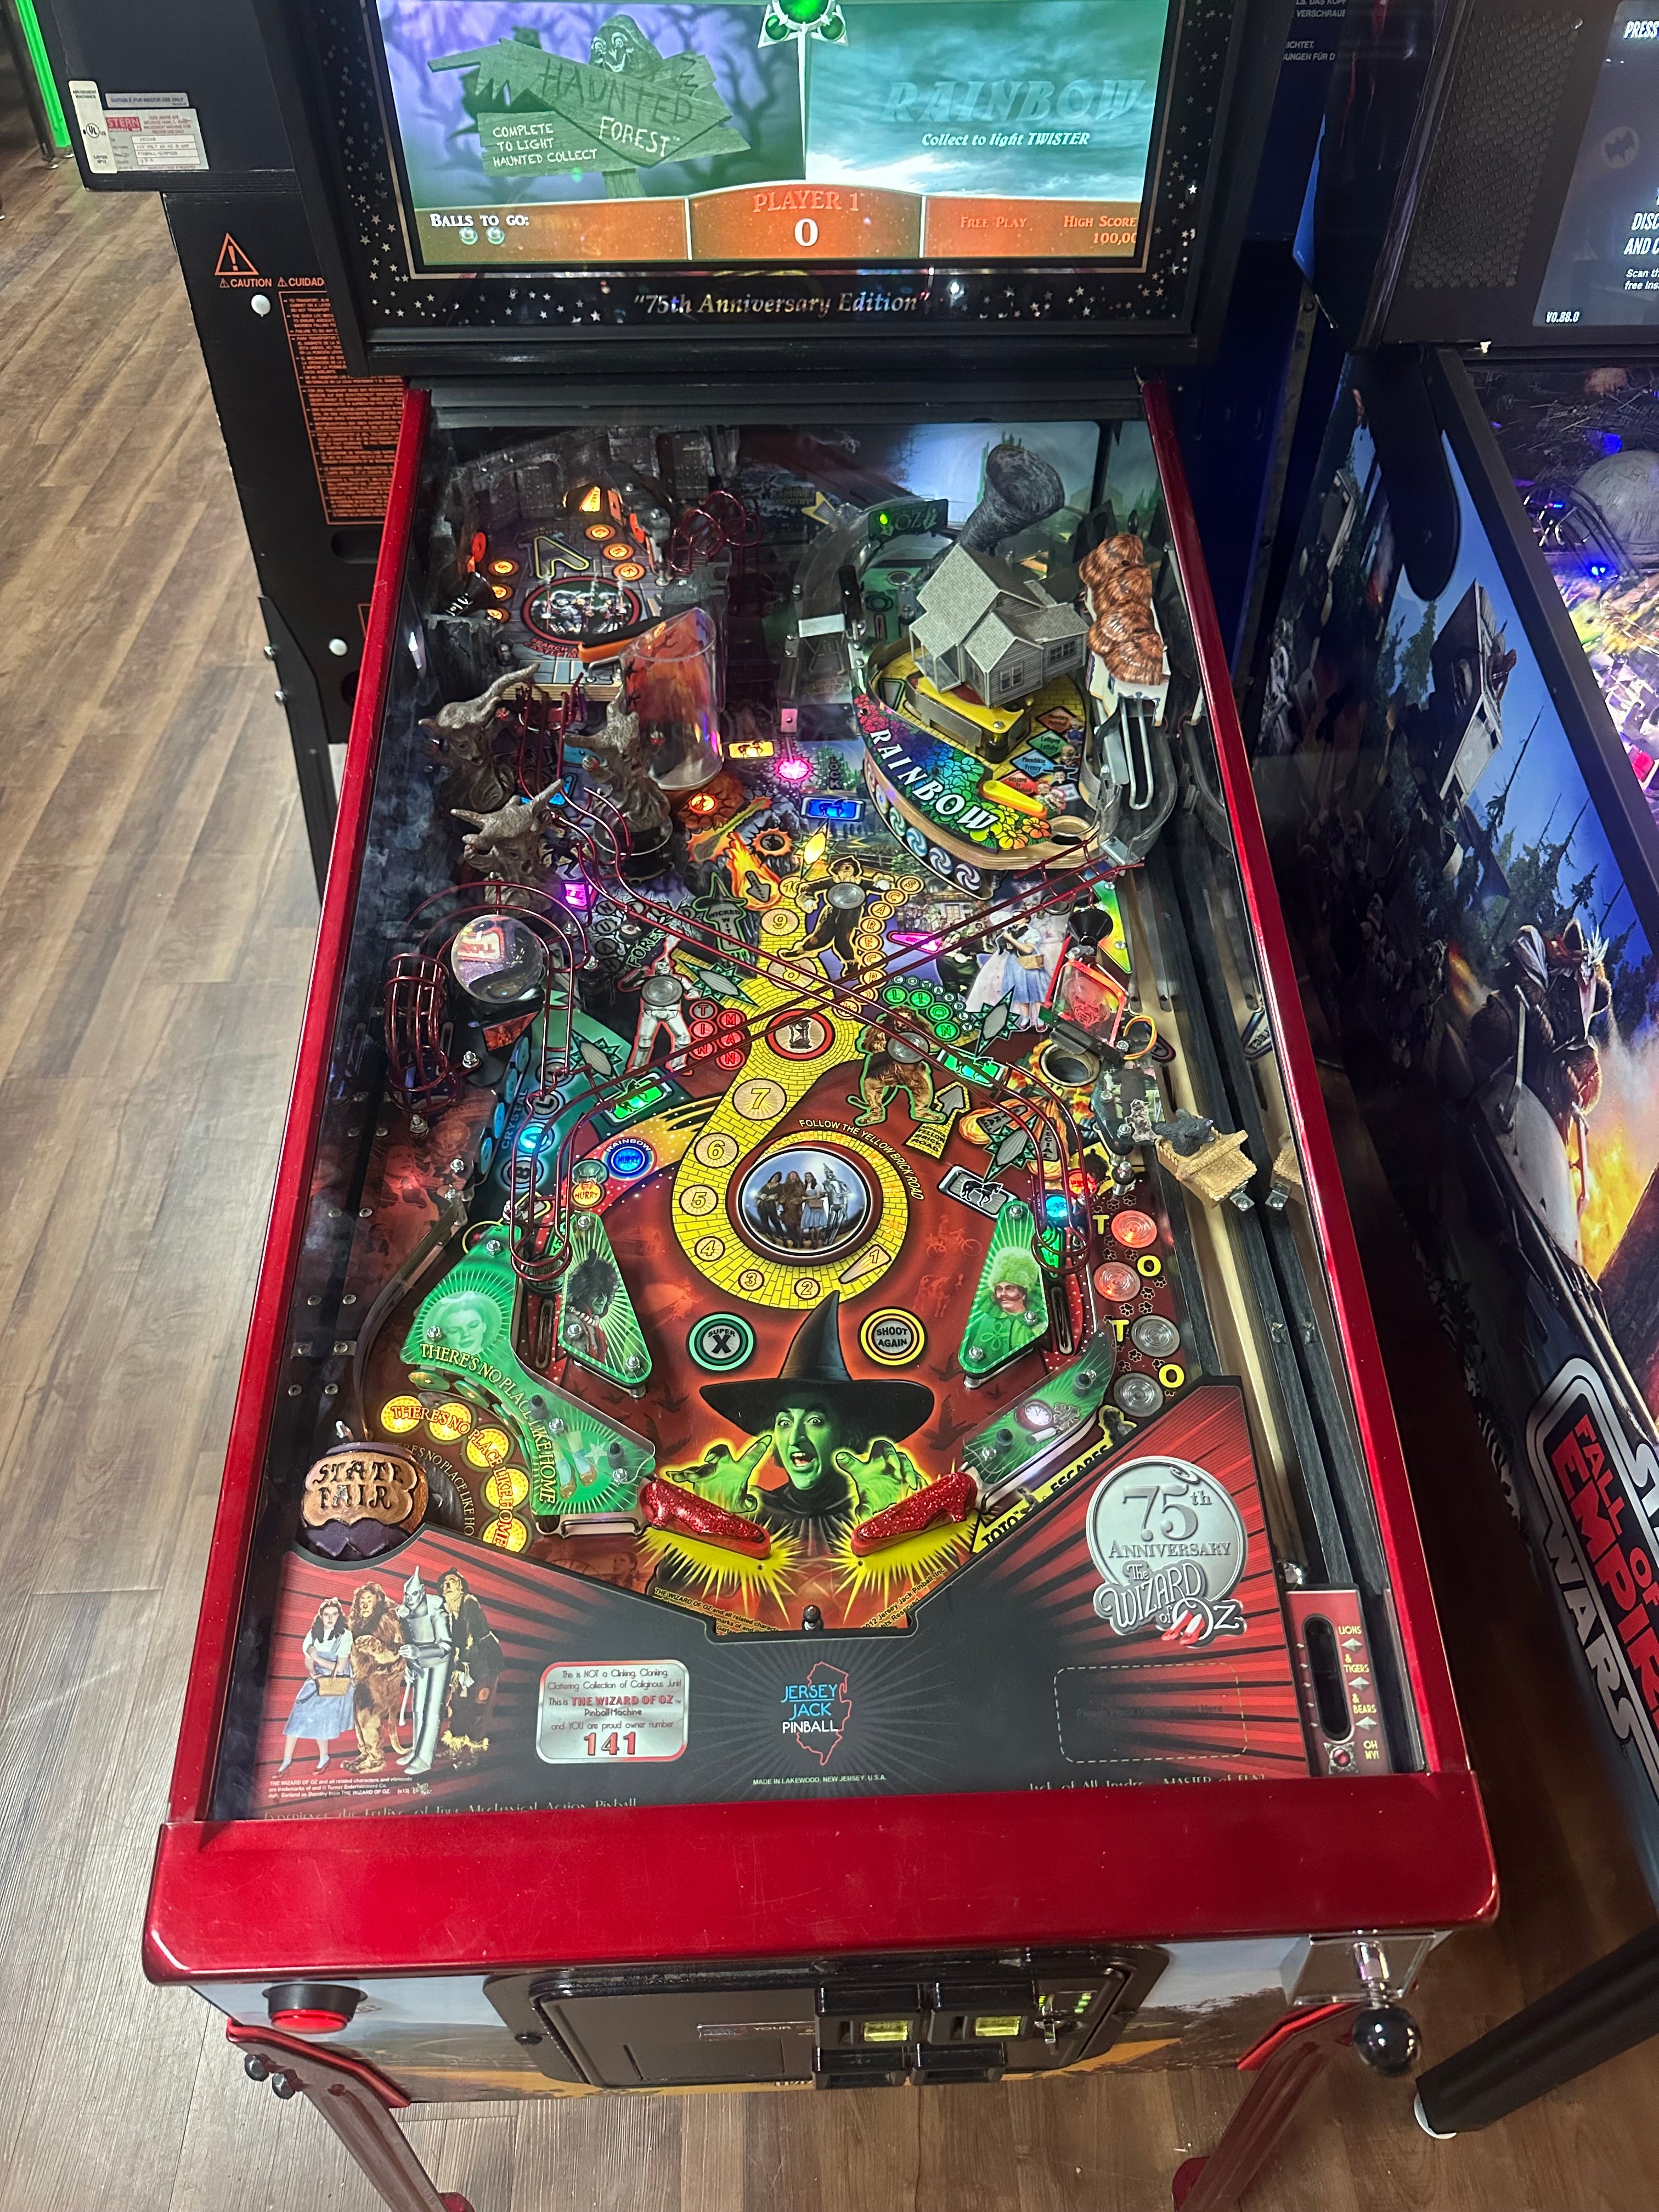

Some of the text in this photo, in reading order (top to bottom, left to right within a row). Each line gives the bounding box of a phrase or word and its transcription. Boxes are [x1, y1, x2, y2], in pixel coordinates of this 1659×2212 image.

[881, 80, 1147, 123] RAINBOW
[107, 117, 139, 127] STERN
[492, 123, 554, 138] COMPLETE
[496, 137, 554, 152] TO LIGHT
[922, 132, 1091, 147] Collect to light TWISTER
[493, 149, 597, 167] HAUNTED COLLECT
[752, 190, 860, 213] PLAYER 1
[794, 218, 819, 247] 0
[1623, 238, 1651, 255] AND
[1626, 269, 1649, 278] Scan
[230, 278, 272, 288] CAUTION
[1624, 280, 1643, 290] free
[698, 294, 831, 318] Anniversary
[523, 641, 564, 658] CASTLE
[530, 636, 568, 652] SEARCH
[829, 757, 840, 789] LOCK
[870, 728, 999, 831] RAINBOW
[708, 909, 741, 919] WICKED
[772, 914, 788, 930] 9
[751, 1094, 771, 1110] 7
[501, 1088, 529, 1150] CRYSTAL
[914, 1133, 941, 1147] BRICK
[917, 1128, 945, 1144] YELLOW
[606, 1138, 653, 1154] RAINBOW
[707, 1139, 725, 1160] 6
[911, 1138, 939, 1152] ROAD
[799, 1119, 925, 1201] FOLLOW THE YELLOW BRICK ROAD
[574, 1191, 599, 1200] HURRY
[691, 1192, 708, 1209] 5
[700, 1240, 716, 1257] 4
[868, 1249, 882, 1265] 1
[744, 1273, 757, 1287] 3
[800, 1280, 814, 1295] 2
[708, 1327, 736, 1338] SUPER
[876, 1327, 909, 1336] SHOOT
[711, 1334, 732, 1355] X
[878, 1338, 908, 1348] AGAIN
[420, 1343, 556, 1504] THERE'S NO LIKE HOME
[312, 1460, 404, 1485] STATE
[391, 1404, 514, 1549] THERE'S NO PLACE LIKE HOME
[1575, 1413, 1625, 1536] FALL
[426, 1449, 475, 1515] NO PLACE LIKE
[318, 1483, 392, 1510] FAIR
[1108, 1539, 1231, 1559] ANNIVERSARY
[1126, 1563, 1149, 1582] The
[878, 1567, 947, 1621] Jersey Jack Pinball, Inc.
[1098, 1563, 1200, 1629] WIZARD
[654, 1587, 668, 1597] THE
[668, 1591, 692, 1605] WIZARD
[703, 1604, 713, 1612] OZ
[733, 1614, 754, 1625] related
[1338, 1626, 1362, 1635] LIONS
[1543, 1518, 1632, 1741] WARS
[1345, 1654, 1352, 1664] &
[562, 1669, 573, 1679] This
[584, 1669, 599, 1678] NOT
[1344, 1664, 1369, 1673] TIGERS
[549, 1681, 579, 1692] Clattering
[583, 1680, 616, 1689] Collection
[620, 1680, 629, 1689] of
[781, 1684, 837, 1703] JERSEY
[549, 1697, 562, 1706] This
[571, 1696, 593, 1706] THE
[595, 1696, 639, 1706] WIZARD
[641, 1695, 657, 1705] OF
[658, 1694, 674, 1704] OZ
[1352, 1693, 1359, 1703] &
[584, 1708, 642, 1717] Pinball Machine
[789, 1703, 832, 1721] JACK
[1353, 1704, 1377, 1714] BEARS
[551, 1722, 565, 1730] and
[601, 1720, 622, 1731] proud
[648, 1719, 674, 1728] number
[782, 1720, 838, 1734] PINBALL
[583, 1731, 636, 1756] 141
[1363, 1740, 1378, 1750] OH
[1365, 1750, 1379, 1760] MY!
